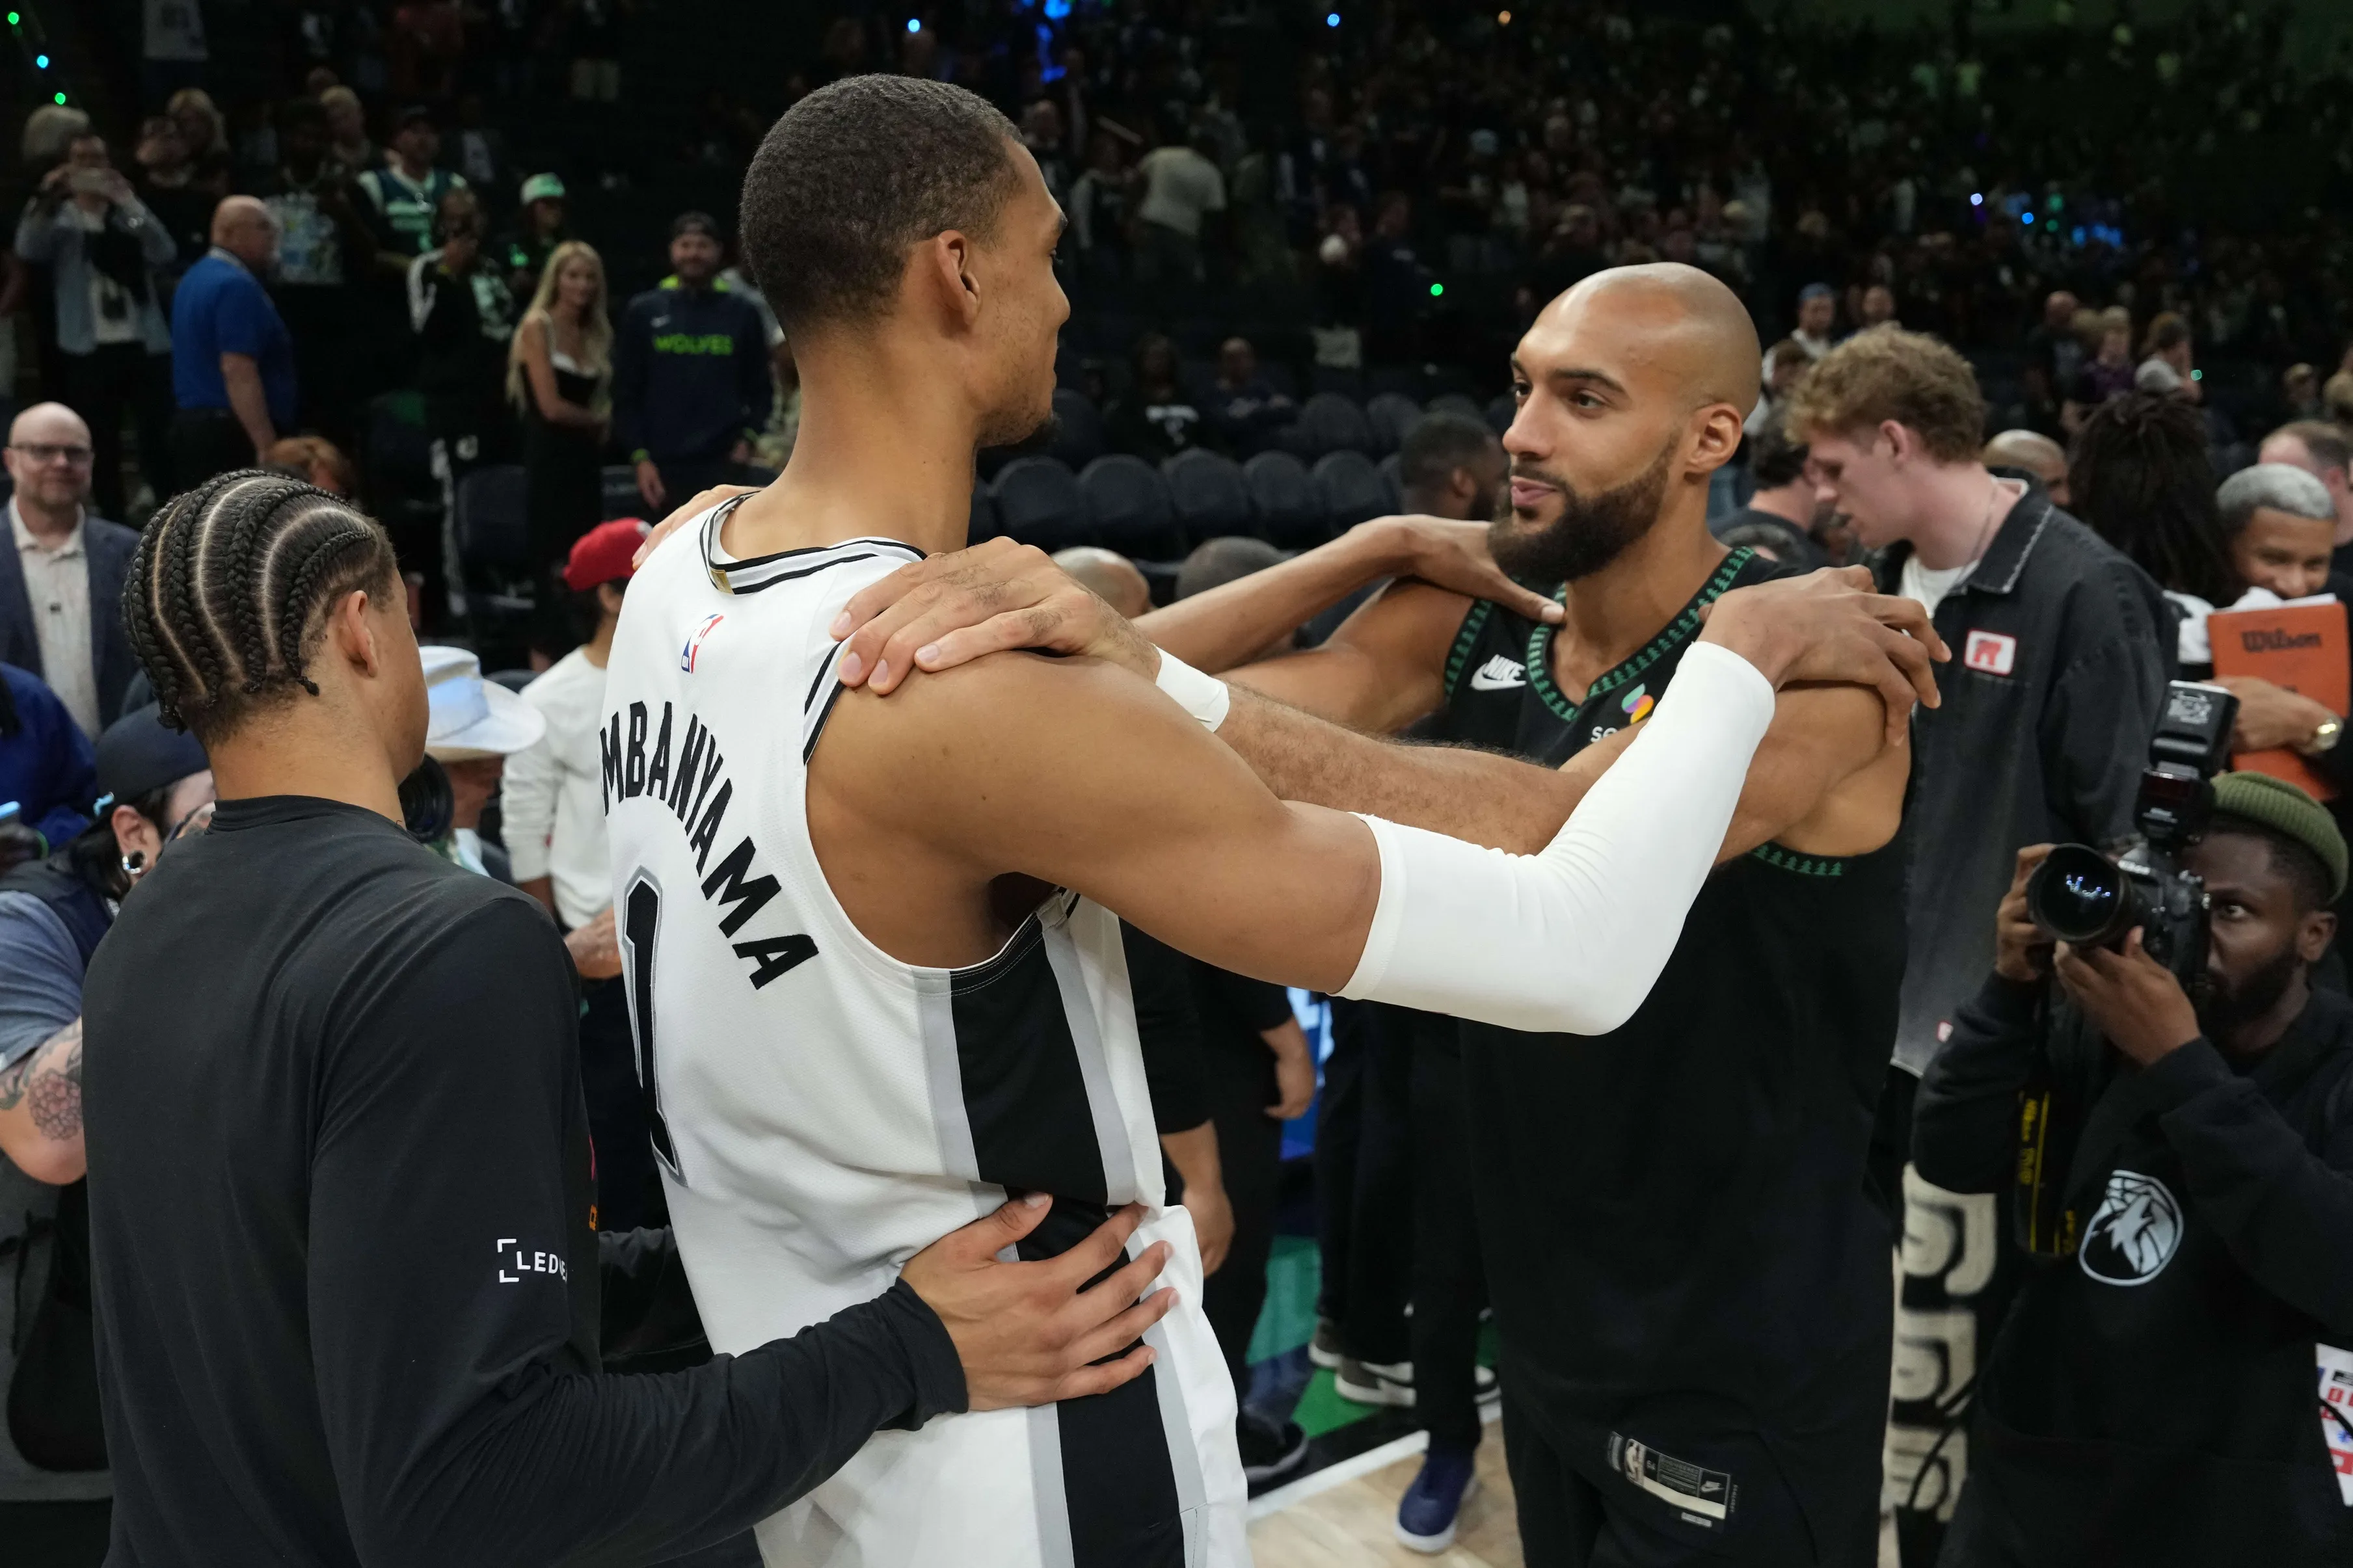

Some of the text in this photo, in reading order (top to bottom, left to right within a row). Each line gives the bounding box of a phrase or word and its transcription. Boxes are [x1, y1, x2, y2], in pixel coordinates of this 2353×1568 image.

[654, 334, 733, 356] WOLVES
[2240, 628, 2322, 652] Wilson
[1484, 654, 1526, 682] NIKE
[612, 865, 689, 1188] 1
